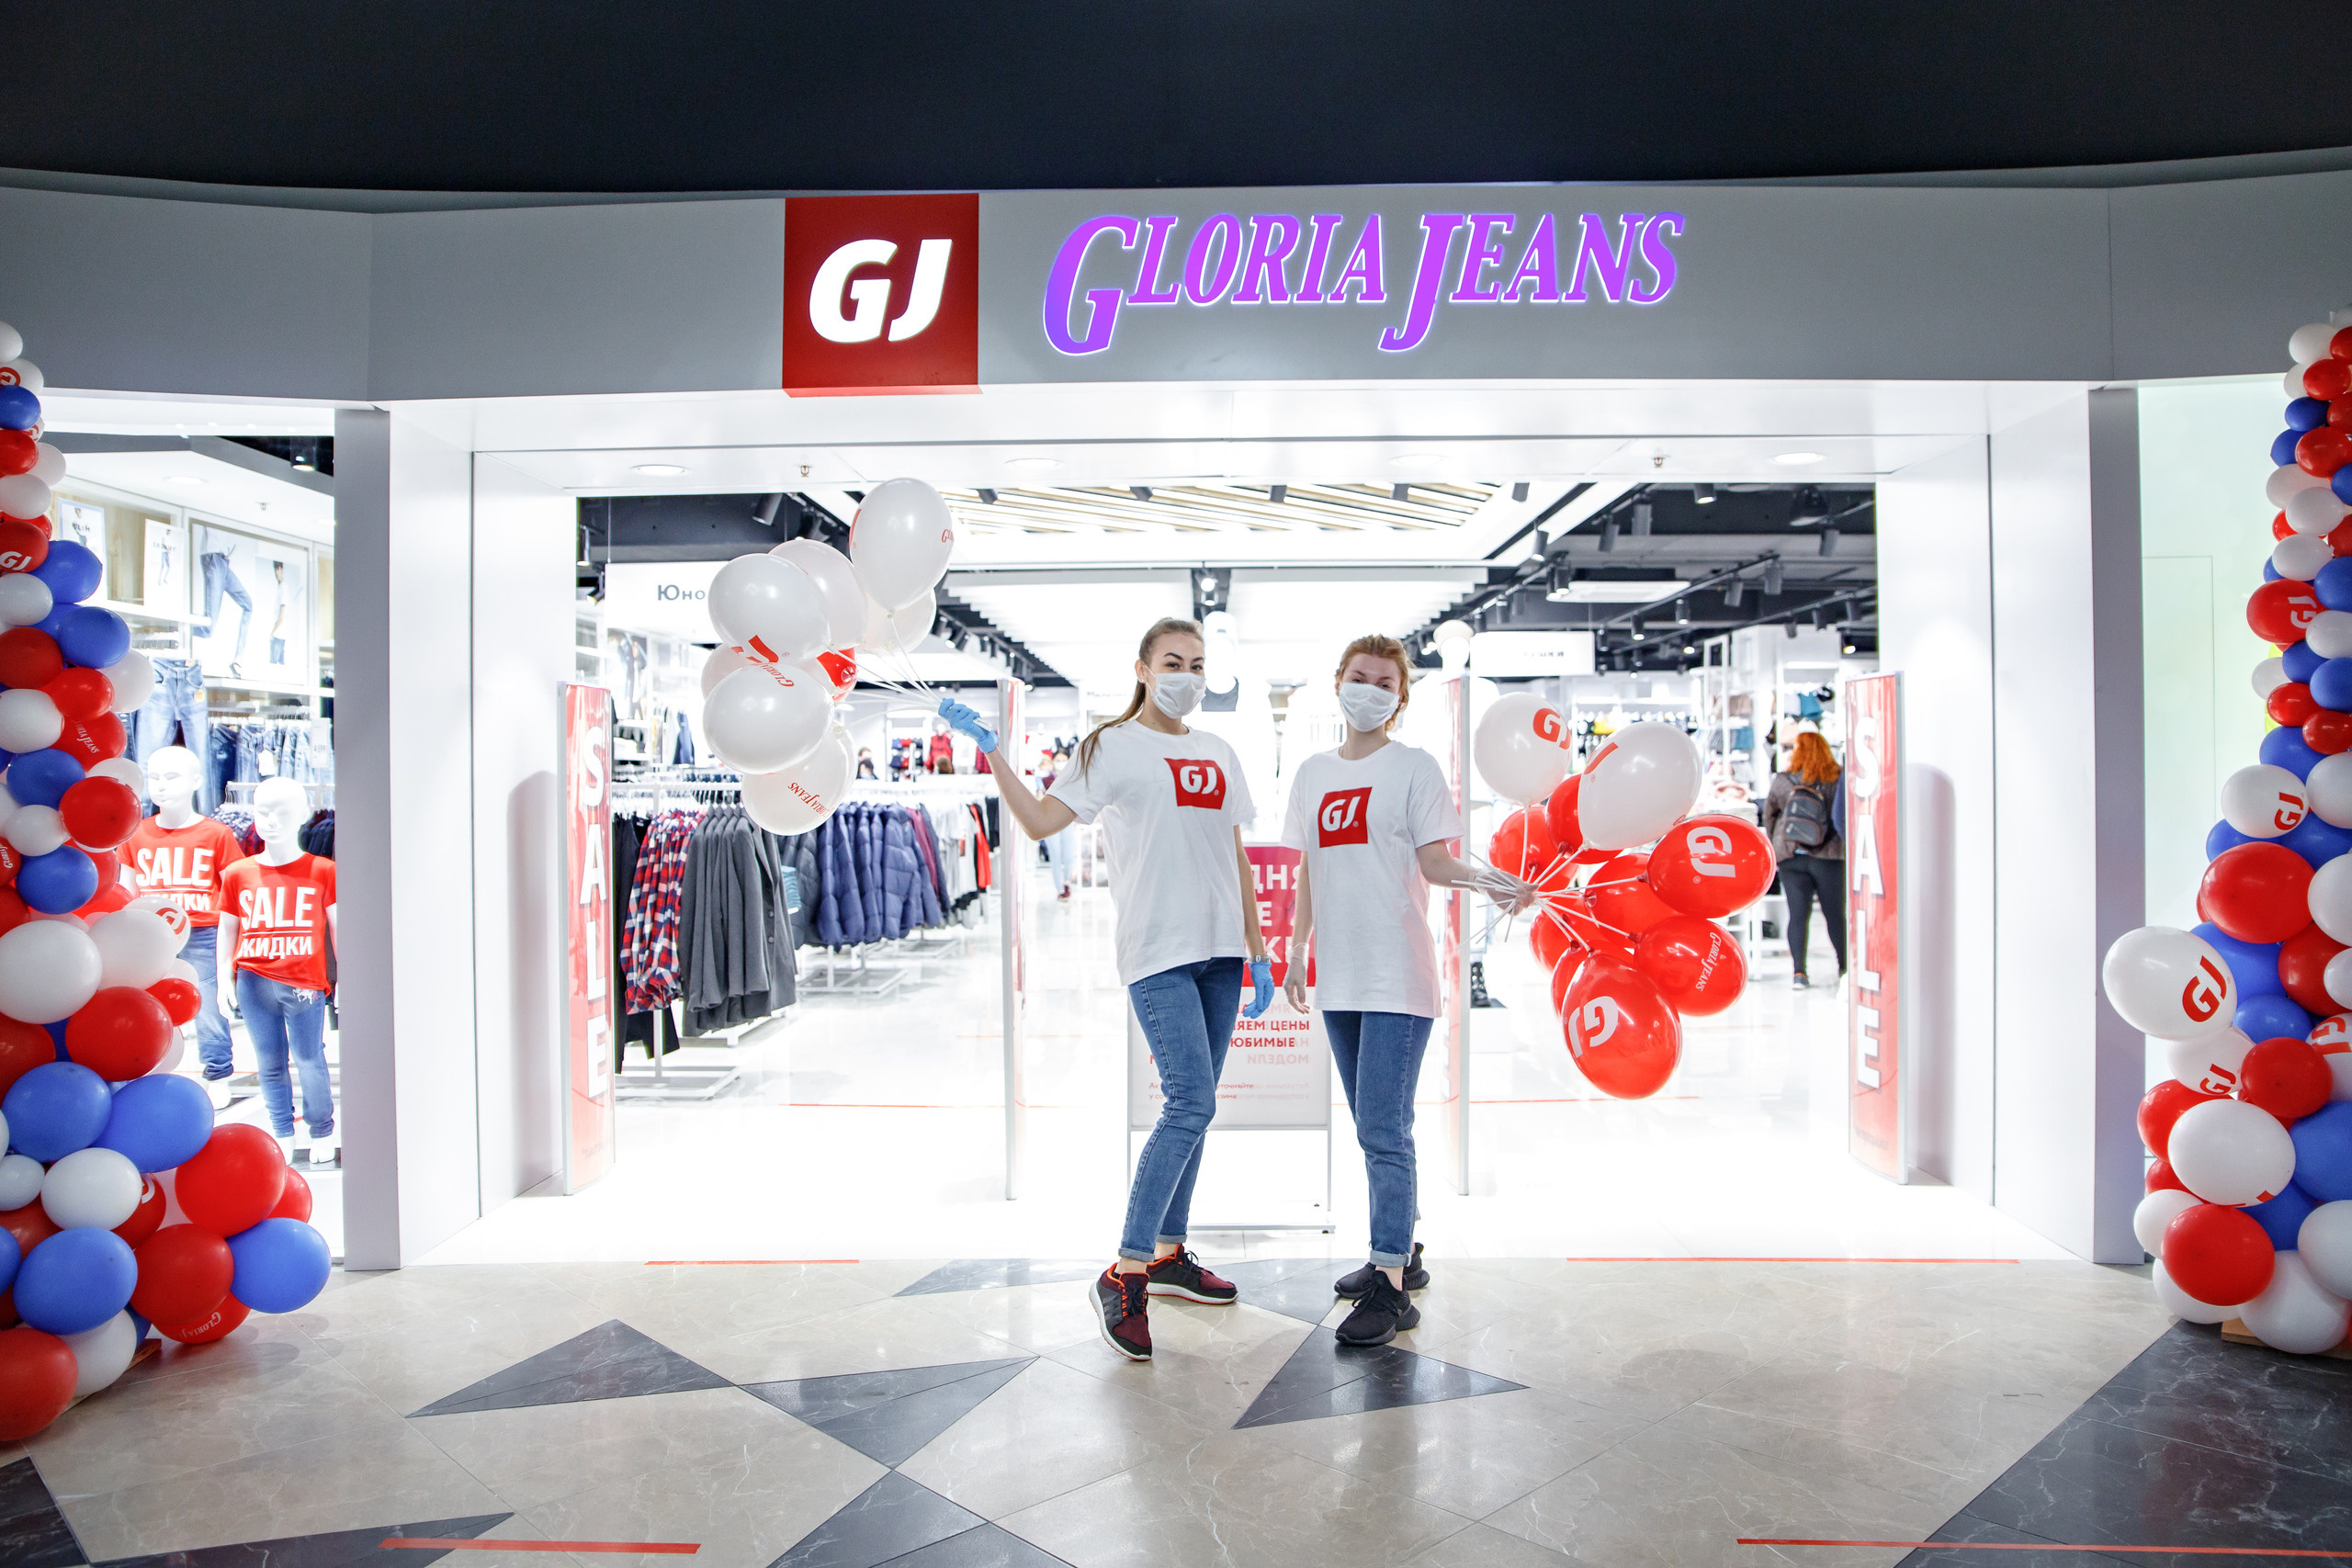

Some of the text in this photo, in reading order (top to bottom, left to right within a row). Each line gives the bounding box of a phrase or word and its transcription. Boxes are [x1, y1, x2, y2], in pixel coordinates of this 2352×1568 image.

[808, 238, 953, 344] GJ
[1042, 211, 1686, 356] GLORIA JEANS
[0, 551, 32, 570] GJ
[2288, 595, 2317, 629] GJ
[1532, 707, 1571, 750] GJ
[787, 782, 820, 805] JEANS
[1179, 765, 1217, 795] GJ
[1321, 795, 1362, 832] GJ
[2274, 791, 2304, 831] GJ
[136, 846, 214, 887] SALE
[1687, 826, 1736, 878] GJ
[238, 886, 316, 931] SALE
[579, 725, 607, 1100] SALE
[1852, 716, 1884, 1090] SALE
[237, 935, 313, 960] КИДКИ
[1695, 931, 1722, 992] GLORIA JEANS
[2182, 954, 2227, 1023] GJ
[1270, 1020, 1310, 1032] ЦЕНЫ
[1567, 996, 1619, 1059] GJ
[2312, 1016, 2352, 1056] GJ
[2199, 1063, 2237, 1095] GJ
